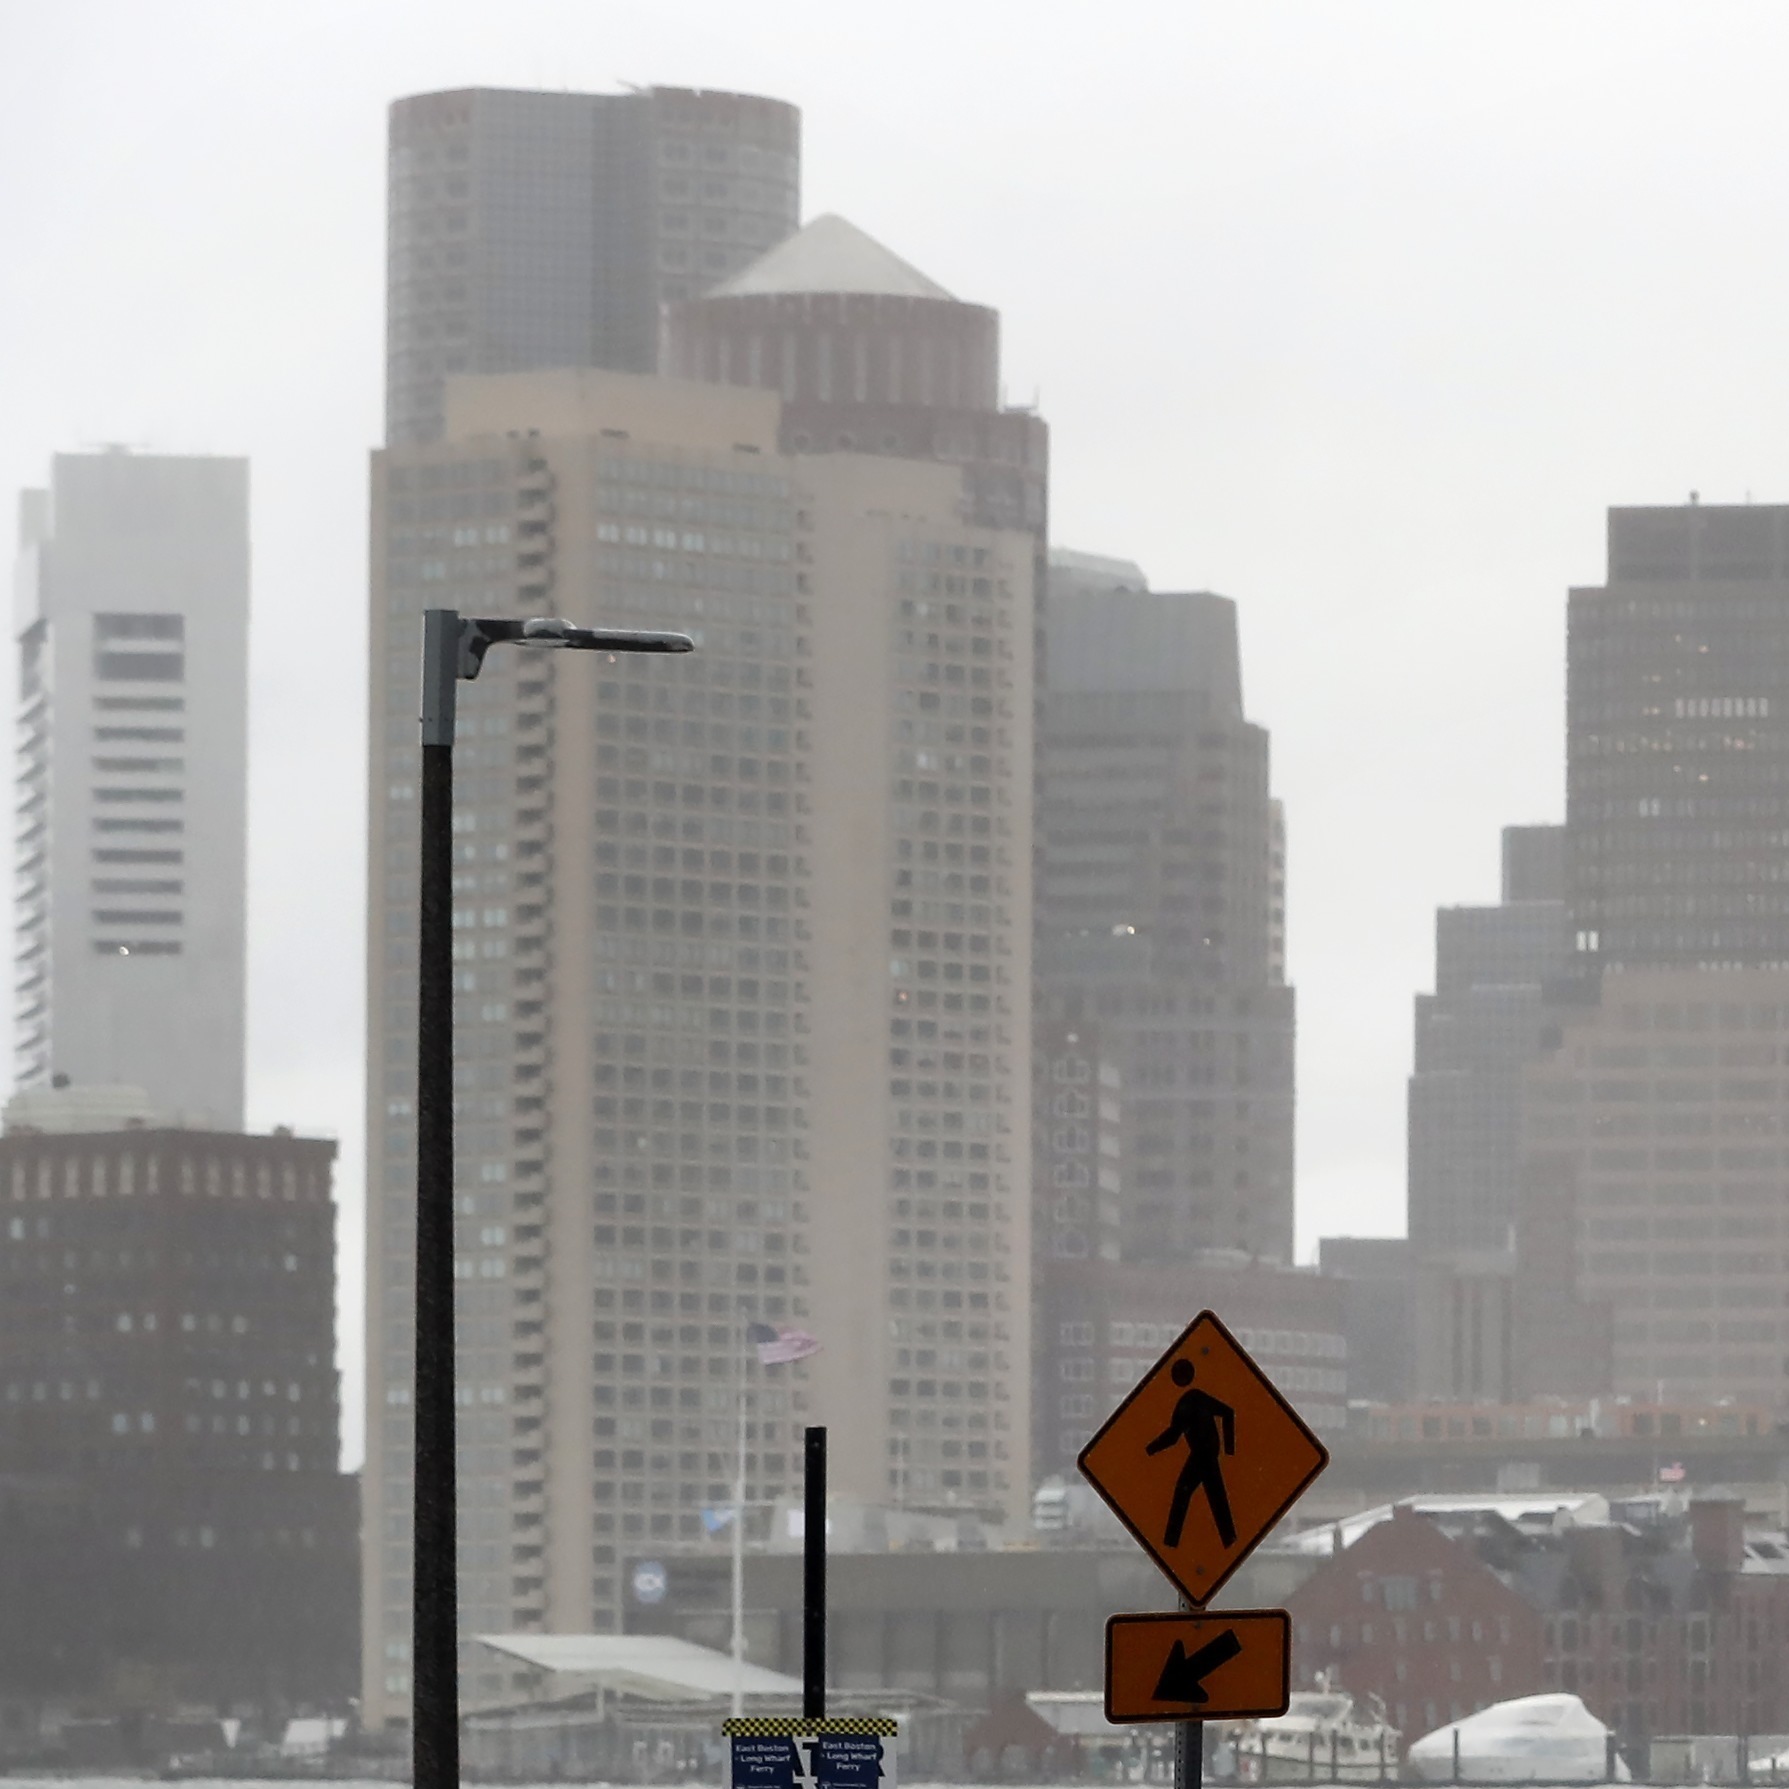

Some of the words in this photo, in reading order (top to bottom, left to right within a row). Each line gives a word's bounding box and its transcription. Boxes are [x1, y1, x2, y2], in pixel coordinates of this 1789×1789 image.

[736, 1744, 755, 1752] East
[757, 1744, 789, 1752] Boston
[823, 1741, 842, 1750] East
[844, 1741, 876, 1750] Boston
[740, 1755, 763, 1764] Long
[826, 1752, 849, 1761] Long
[850, 1752, 877, 1760] Wharf
[750, 1765, 775, 1774] Ferry
[836, 1762, 861, 1771] Ferry
